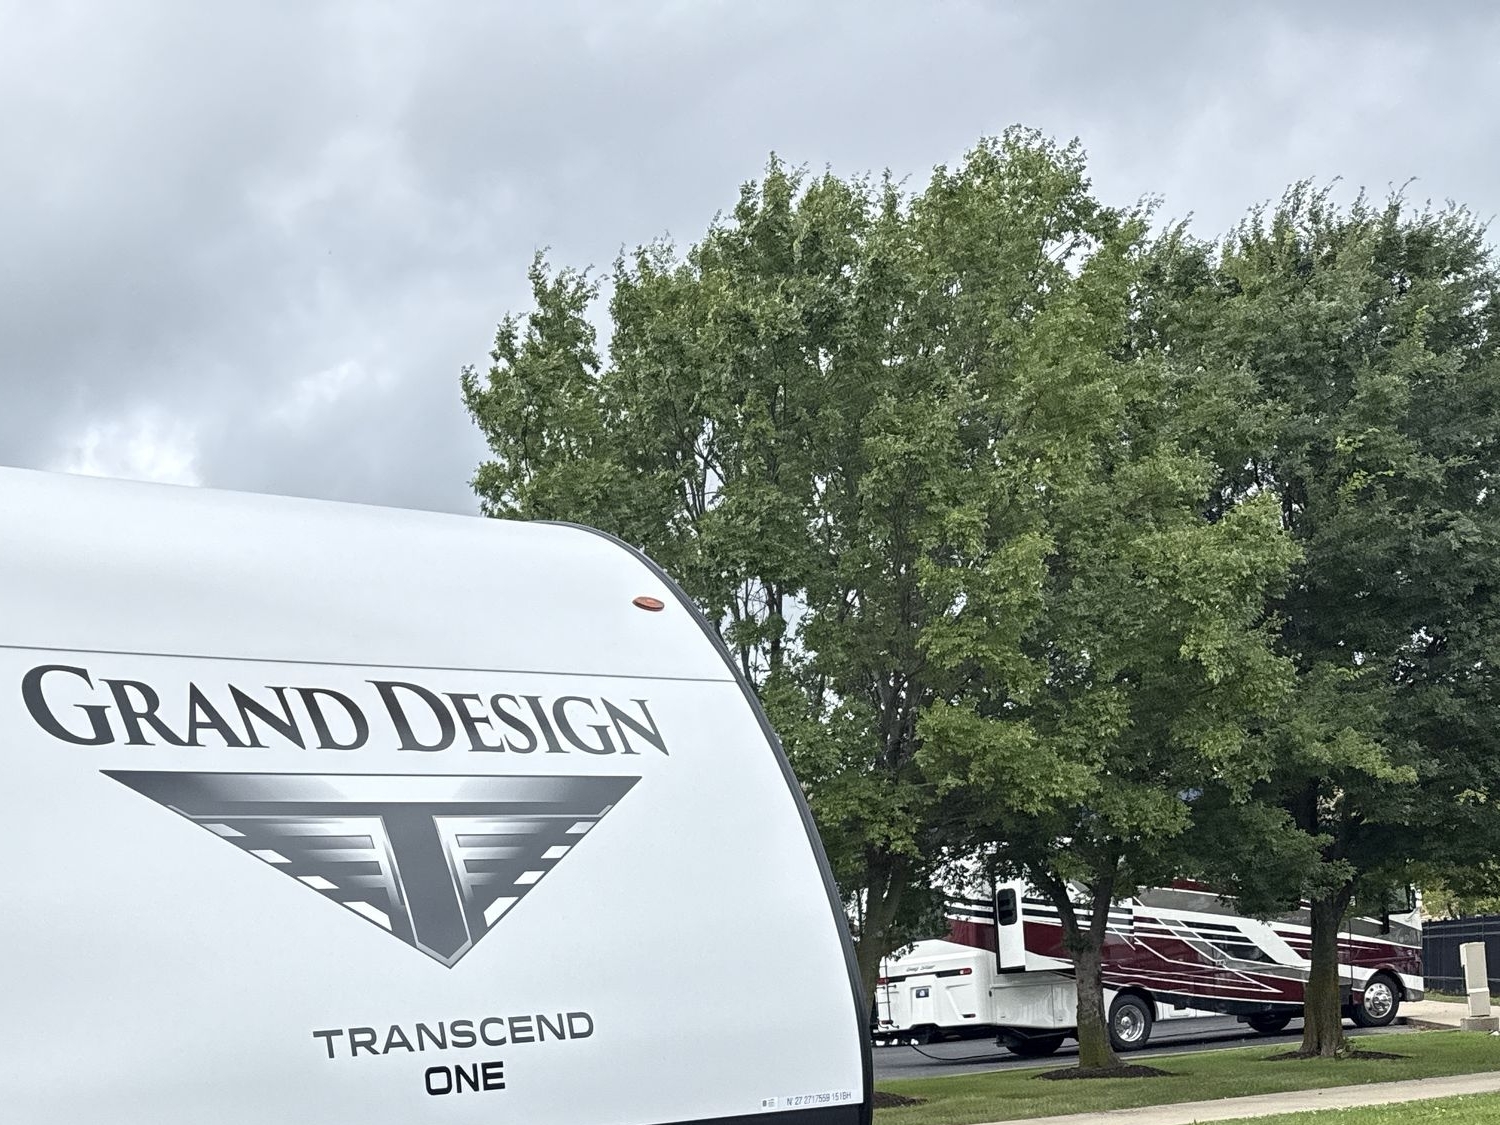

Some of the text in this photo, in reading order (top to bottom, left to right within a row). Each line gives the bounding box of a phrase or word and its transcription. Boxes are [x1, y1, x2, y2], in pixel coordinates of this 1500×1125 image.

[21, 664, 670, 756] GRAND DESIGN
[313, 1011, 595, 1059] TRANSCEND
[425, 1061, 506, 1096] ONE
